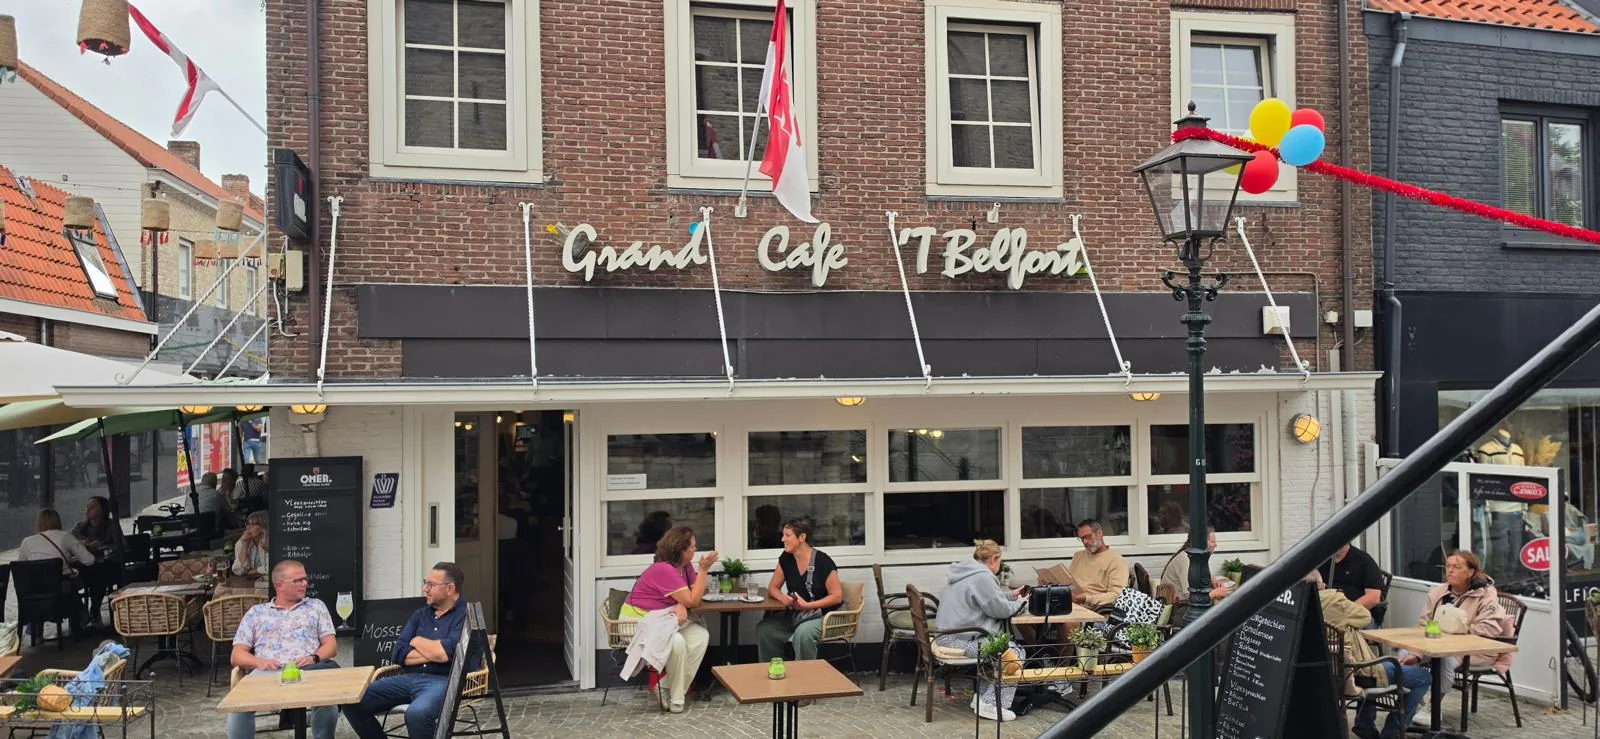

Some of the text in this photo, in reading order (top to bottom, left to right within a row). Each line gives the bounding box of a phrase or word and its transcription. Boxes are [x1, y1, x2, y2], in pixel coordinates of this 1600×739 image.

[562, 222, 708, 282] Grand
[757, 222, 849, 288] Cafe
[941, 227, 1083, 290] Belfort
[1527, 546, 1550, 563] SAL
[362, 623, 403, 640] MOSSE
